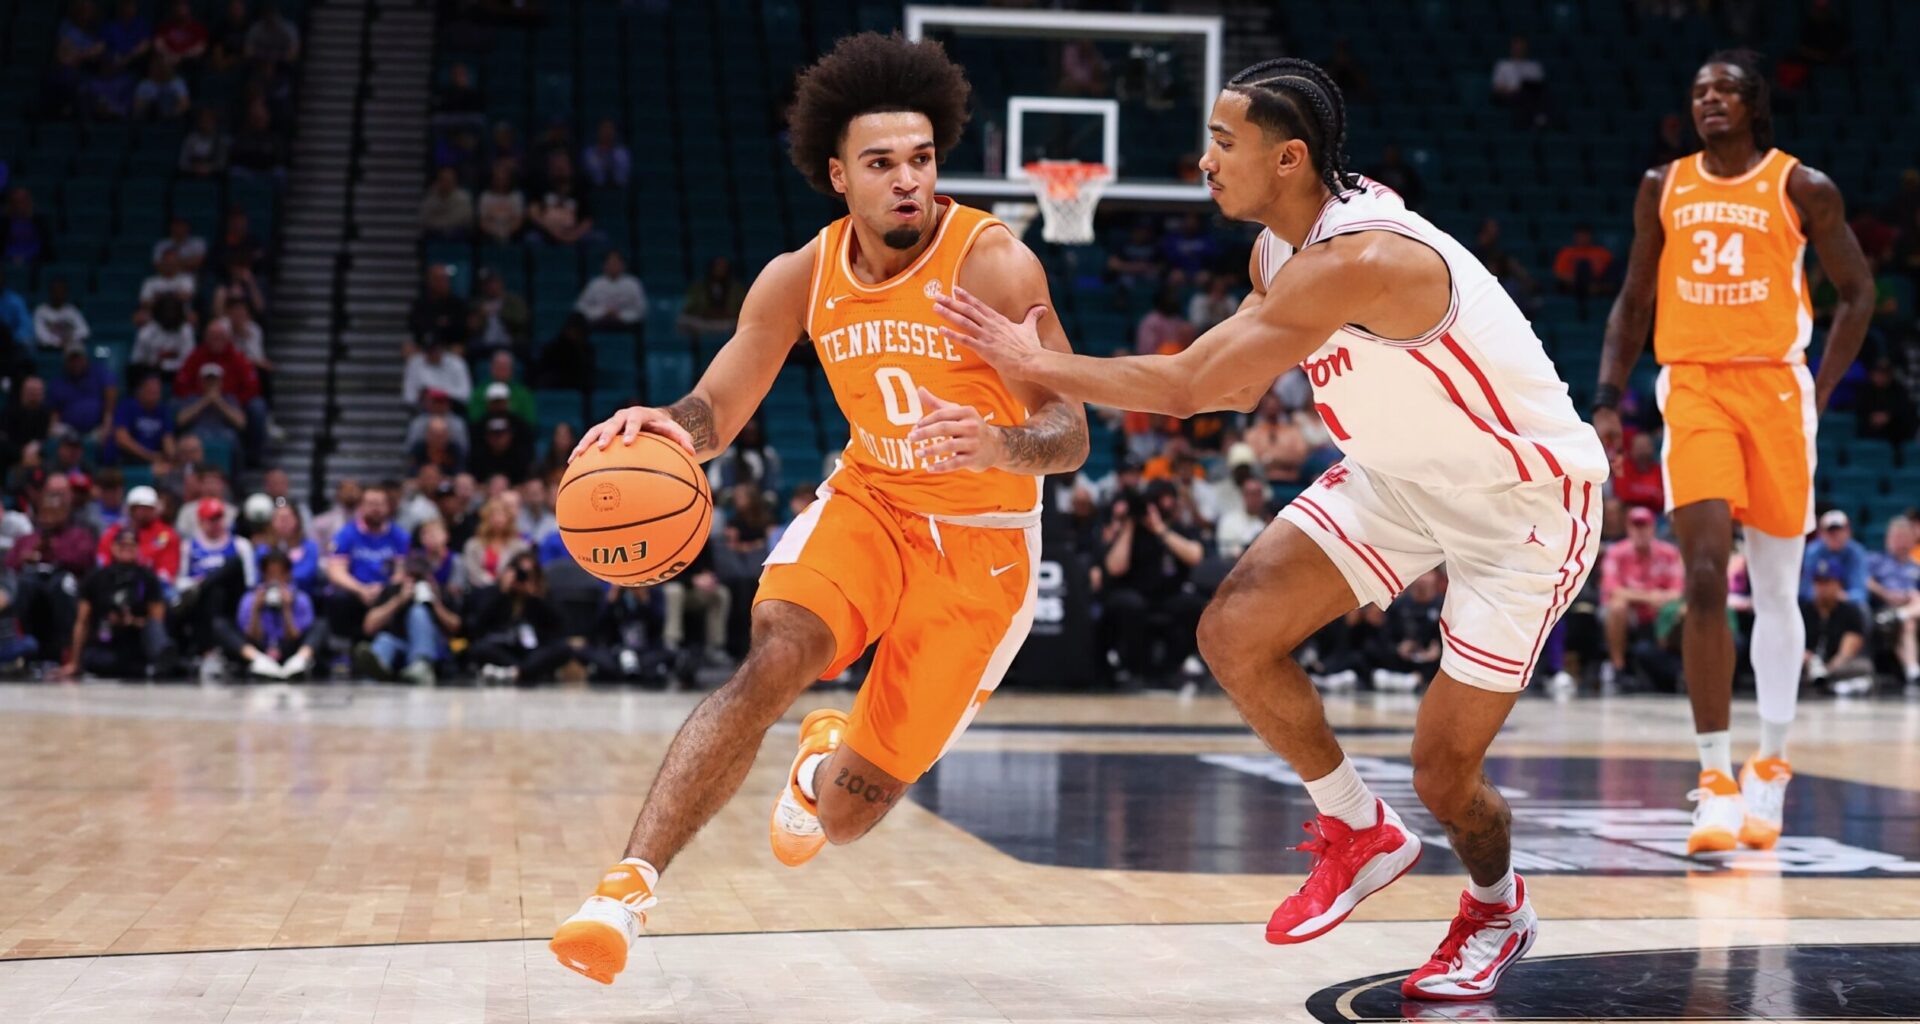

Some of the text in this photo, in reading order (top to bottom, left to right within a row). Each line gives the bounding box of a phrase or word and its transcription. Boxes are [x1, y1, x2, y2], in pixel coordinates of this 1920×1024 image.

[1672, 201, 1770, 233] TENNESSEE
[1691, 230, 1745, 276] 34
[819, 320, 962, 363] TENNESSEE
[592, 541, 647, 564] EVO
